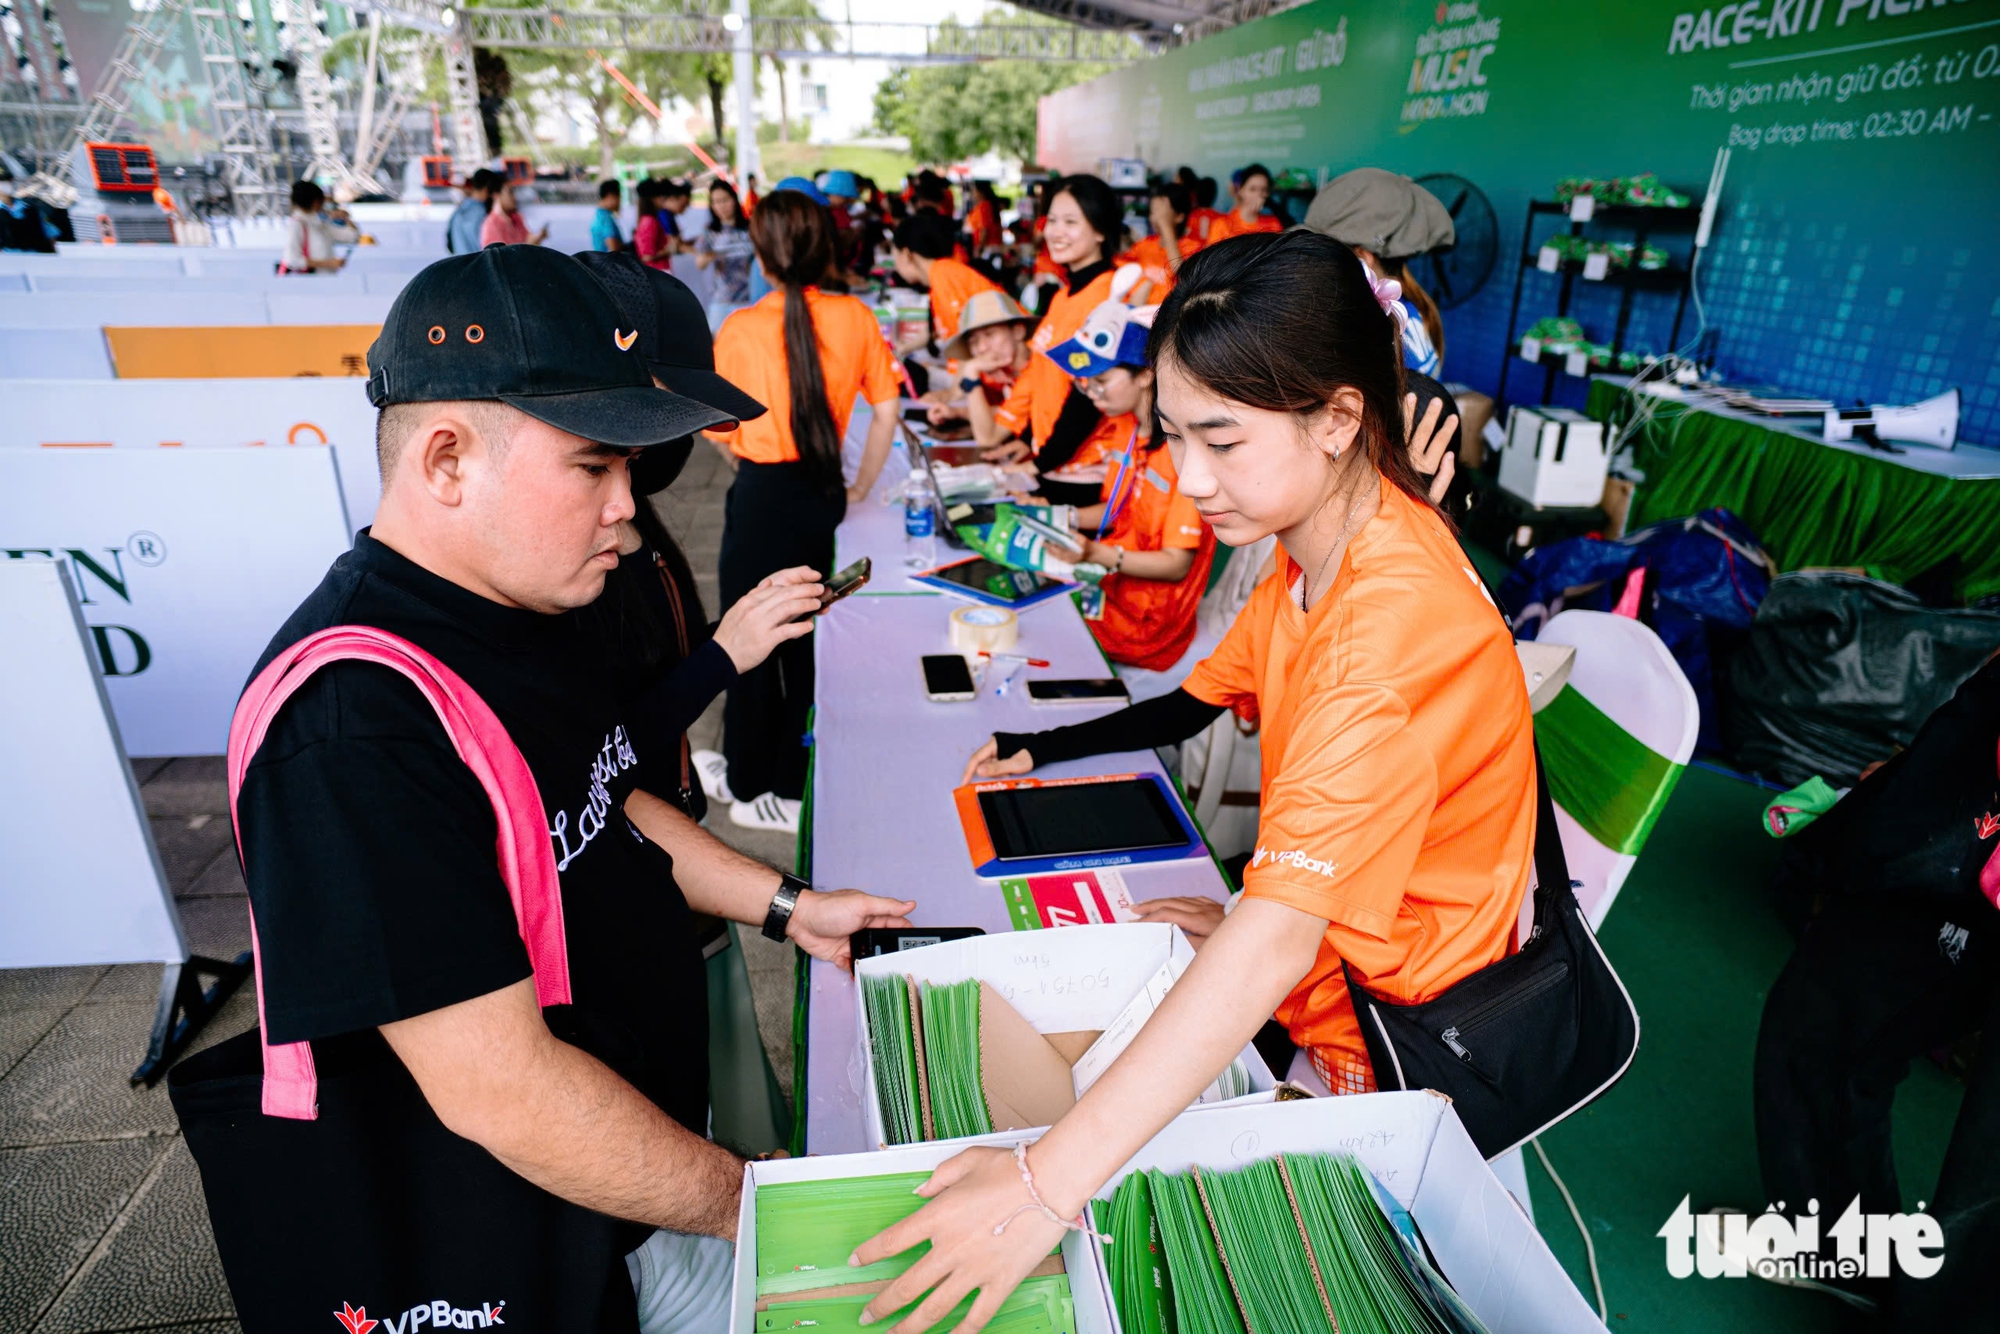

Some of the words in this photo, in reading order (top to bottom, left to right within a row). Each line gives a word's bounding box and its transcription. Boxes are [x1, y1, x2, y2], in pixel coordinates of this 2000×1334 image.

[1406, 43, 1496, 95] MUSIC
[1728, 78, 1773, 113] gian
[1775, 71, 1832, 106] nhận
[1728, 123, 1763, 150] Bag
[1764, 120, 1807, 147] drop
[1863, 108, 1926, 139] 02:30
[1927, 104, 1975, 134] AM
[1270, 849, 1336, 878] VPBank
[383, 1299, 506, 1334] VPBank
